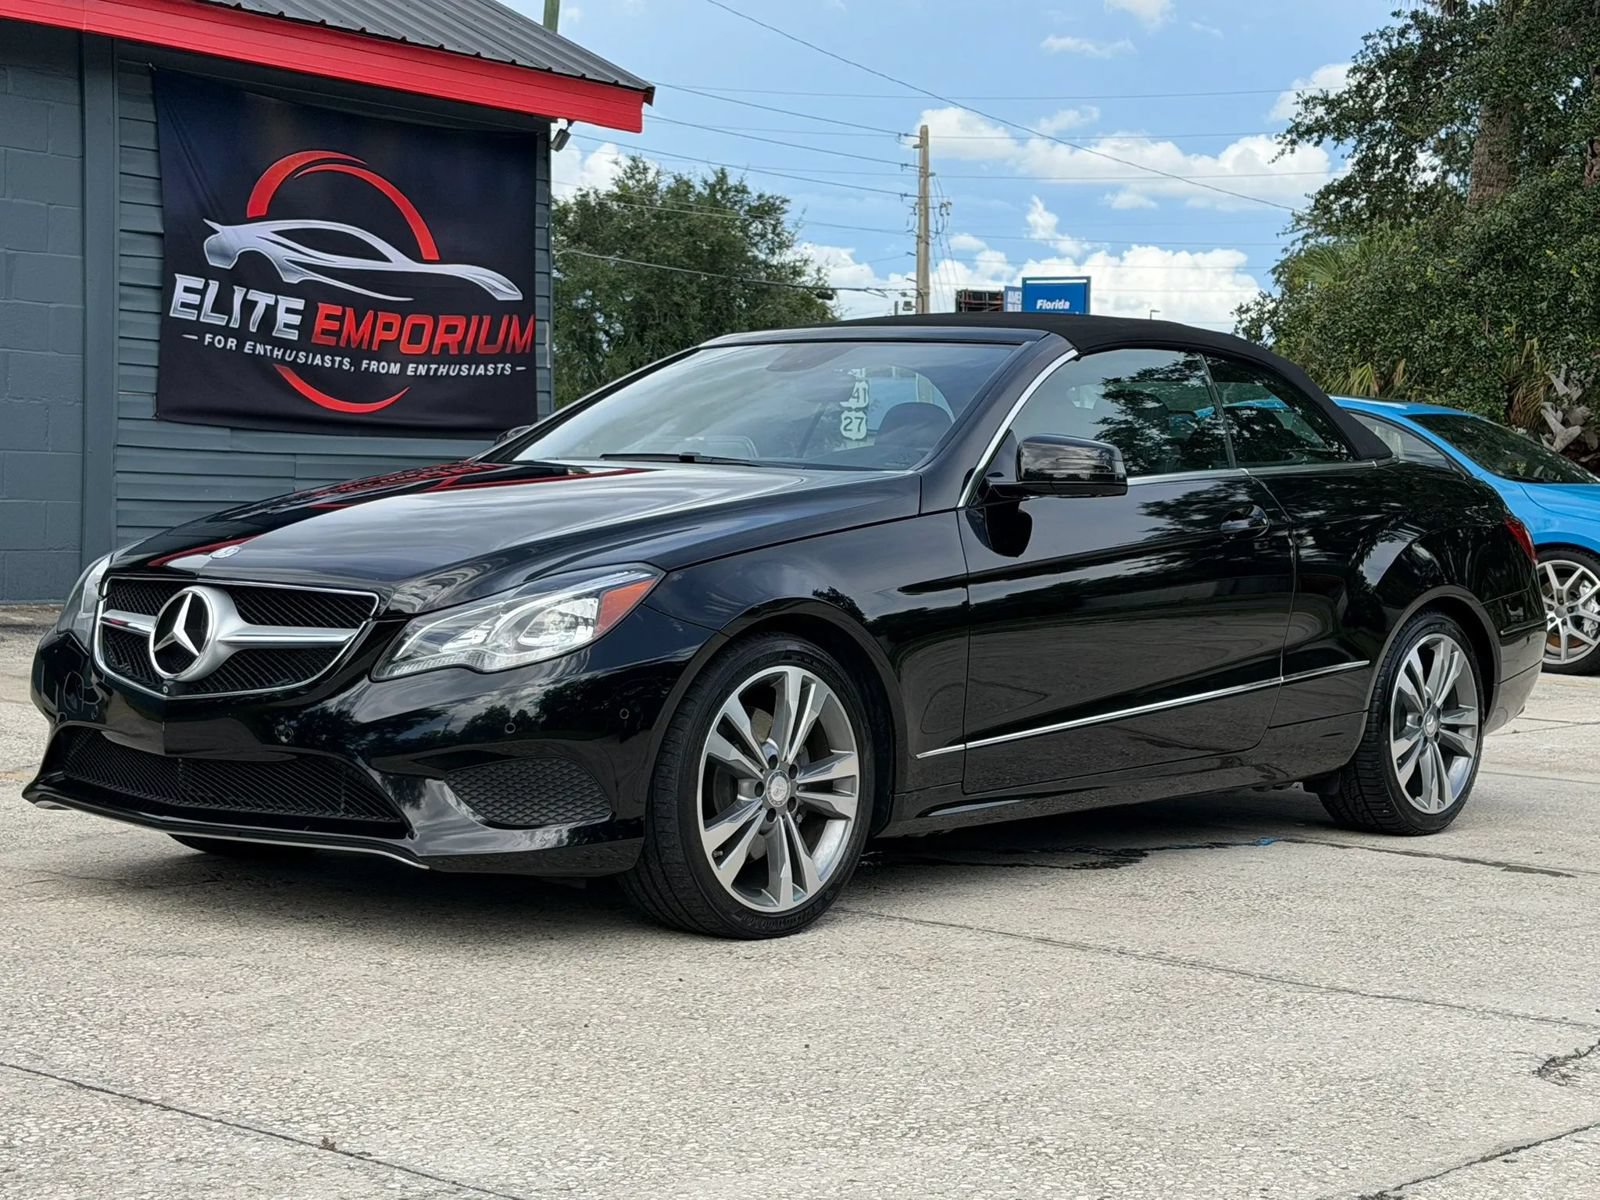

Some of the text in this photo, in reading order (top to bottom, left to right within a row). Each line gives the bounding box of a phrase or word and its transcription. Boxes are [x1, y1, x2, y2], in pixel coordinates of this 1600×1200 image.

[168, 273, 535, 356] ELITE EMPORIUM
[1036, 299, 1070, 311] Florida
[203, 333, 513, 377] FOR ENTHUSIASTS, FROM ENTHUSIASTS
[843, 416, 865, 433] 27
